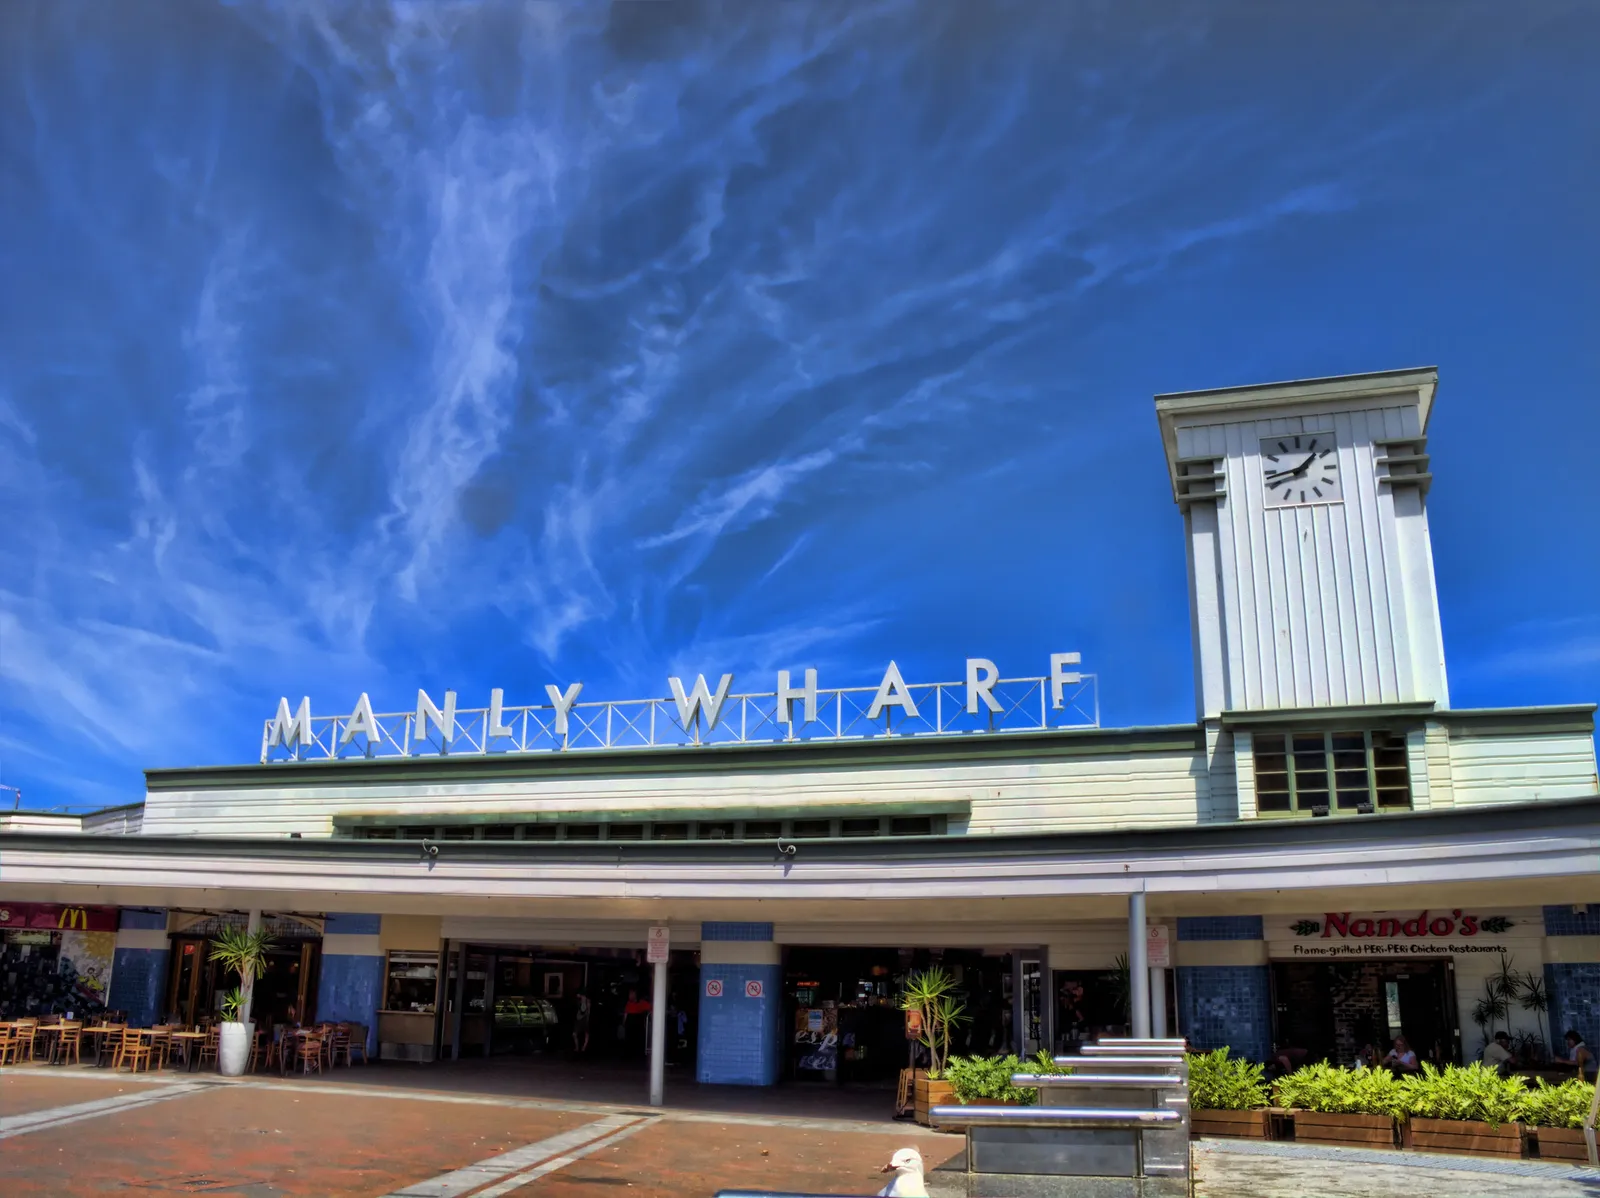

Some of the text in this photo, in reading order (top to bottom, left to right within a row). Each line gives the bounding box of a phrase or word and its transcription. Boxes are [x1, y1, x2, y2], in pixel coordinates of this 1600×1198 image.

[269, 652, 1081, 747] MANLY WHARF
[1320, 909, 1479, 938] Nando's
[1293, 944, 1362, 956] Flame-grilled
[1409, 944, 1447, 954] Chicken
[1448, 944, 1508, 954] Restaurants
